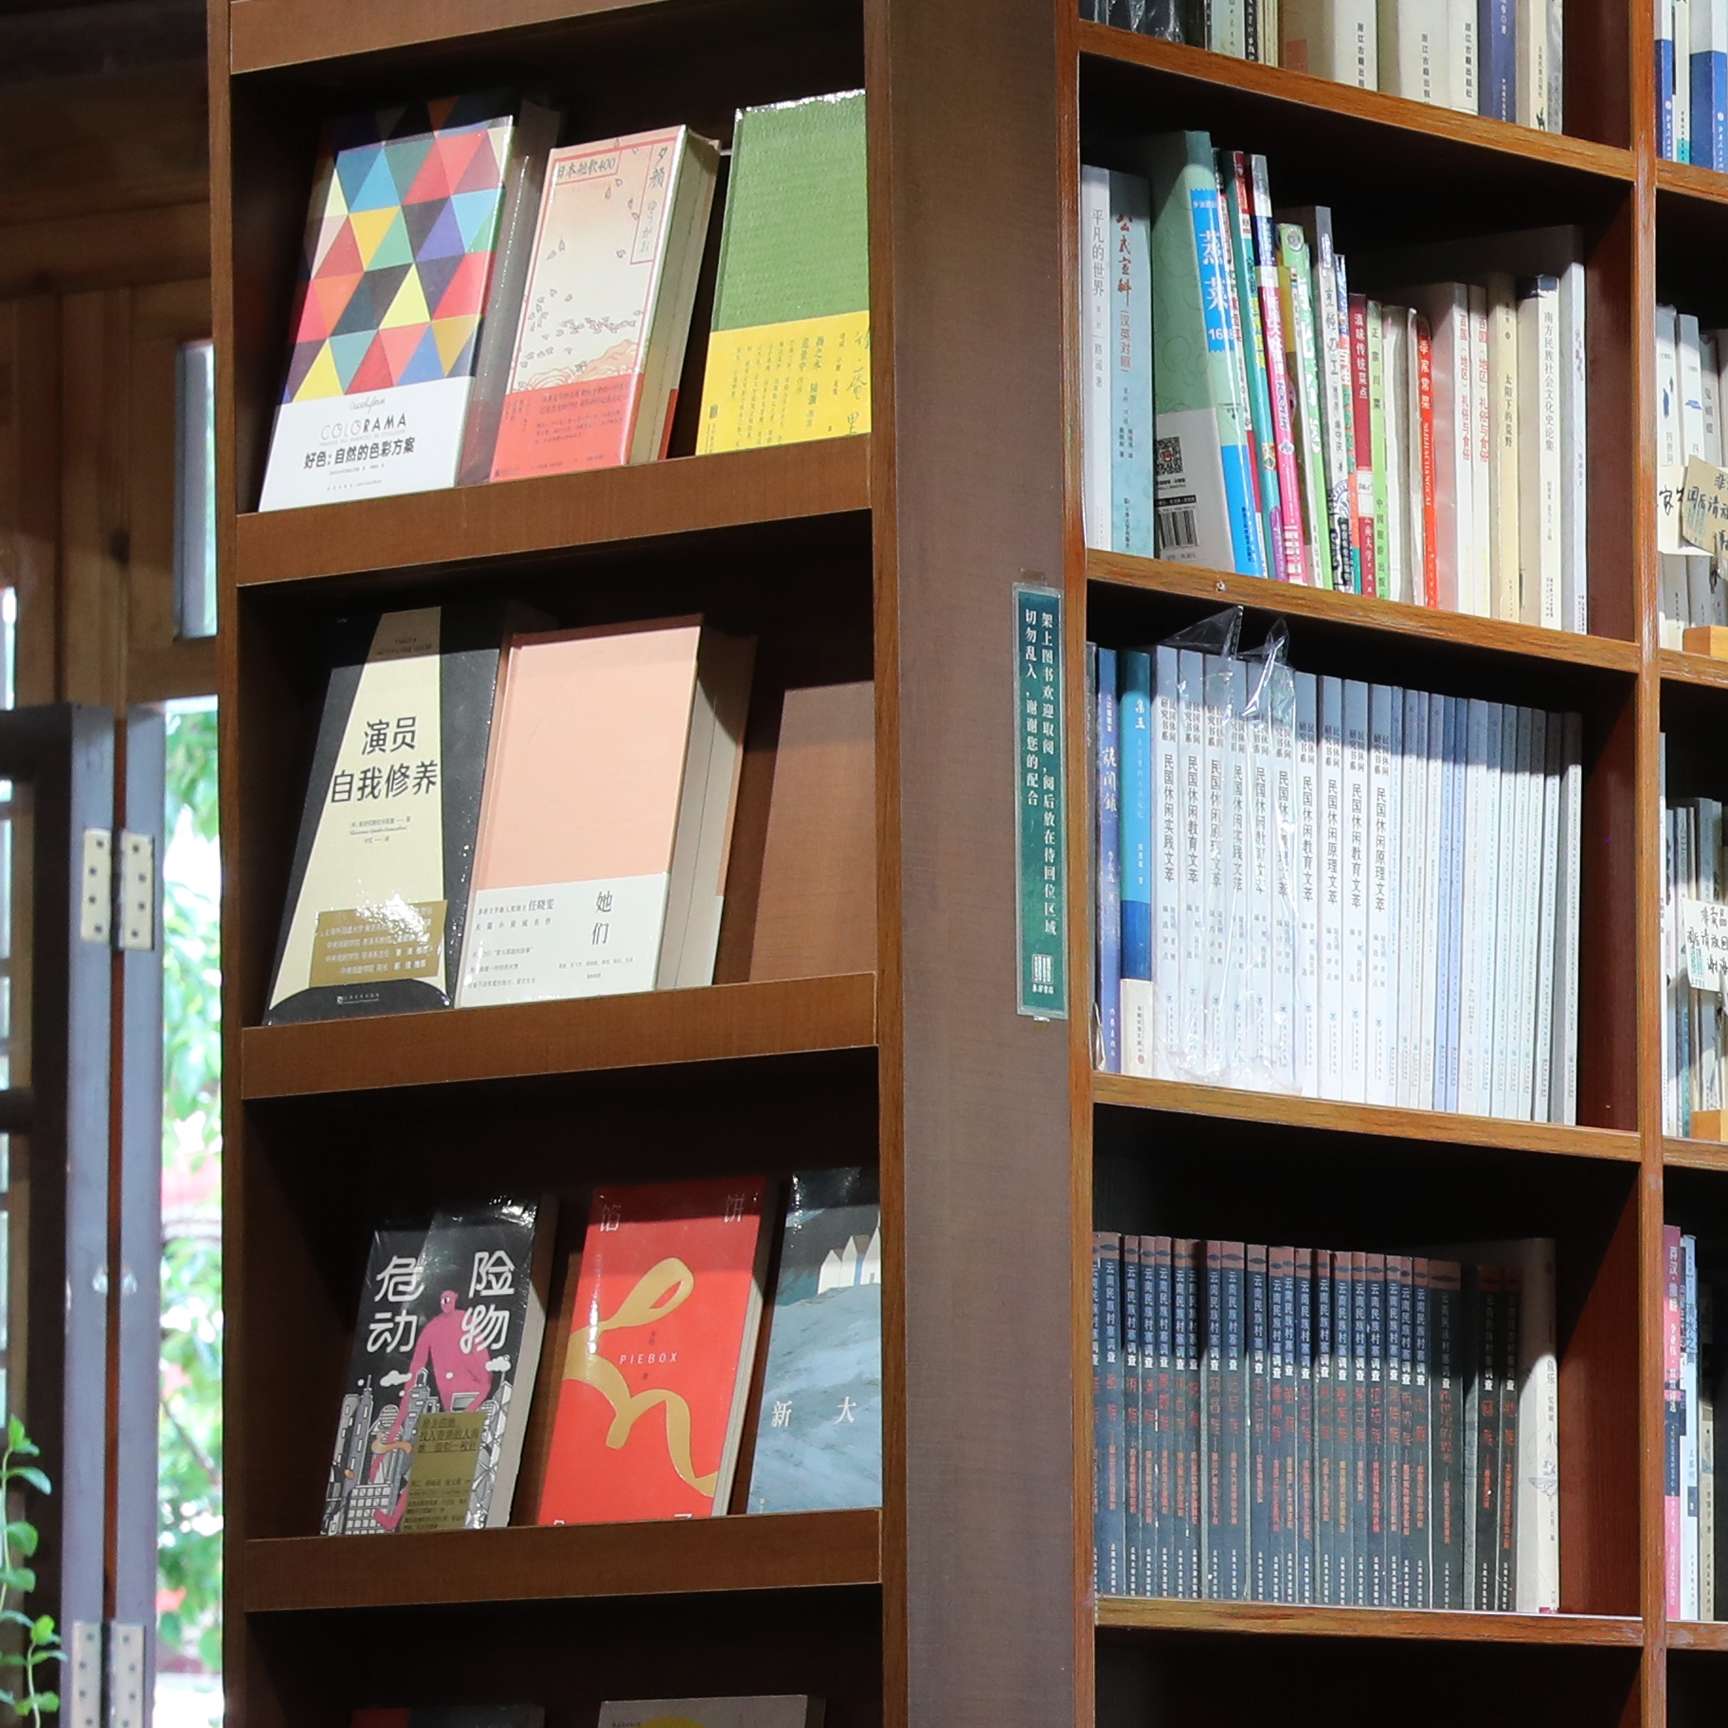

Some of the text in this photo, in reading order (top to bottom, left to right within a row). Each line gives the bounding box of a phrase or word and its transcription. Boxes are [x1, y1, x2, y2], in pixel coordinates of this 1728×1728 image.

[320, 413, 408, 441] COLORAMA
[361, 716, 418, 757] 演员
[330, 759, 438, 804] 自我修养
[591, 889, 615, 946] 她们
[373, 1249, 517, 1303] 危险
[366, 1303, 511, 1355] 动物
